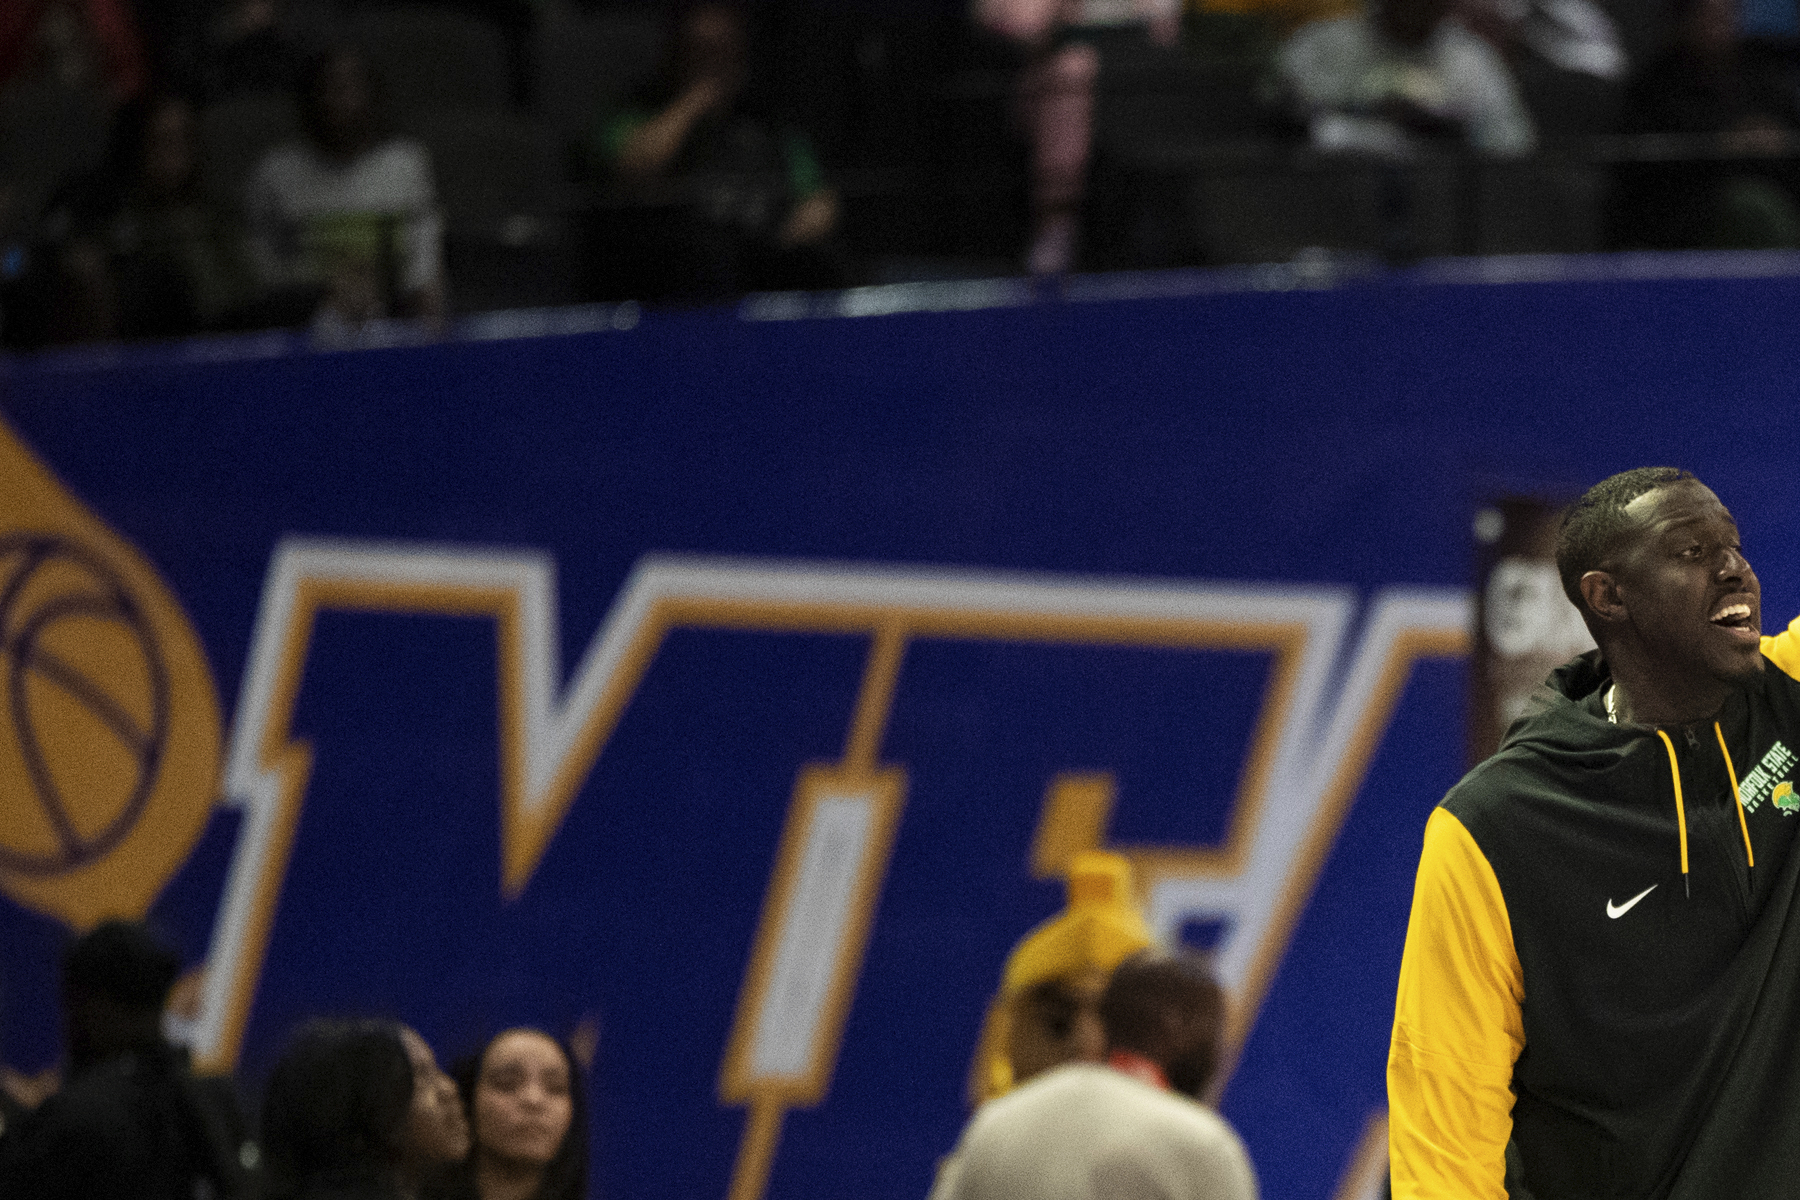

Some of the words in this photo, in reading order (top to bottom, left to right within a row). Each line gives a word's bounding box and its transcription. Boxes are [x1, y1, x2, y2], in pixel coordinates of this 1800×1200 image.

[1738, 764, 1772, 807] NORFOLK
[1761, 740, 1792, 774] STATE
[1747, 755, 1799, 814] BASKETBALL
